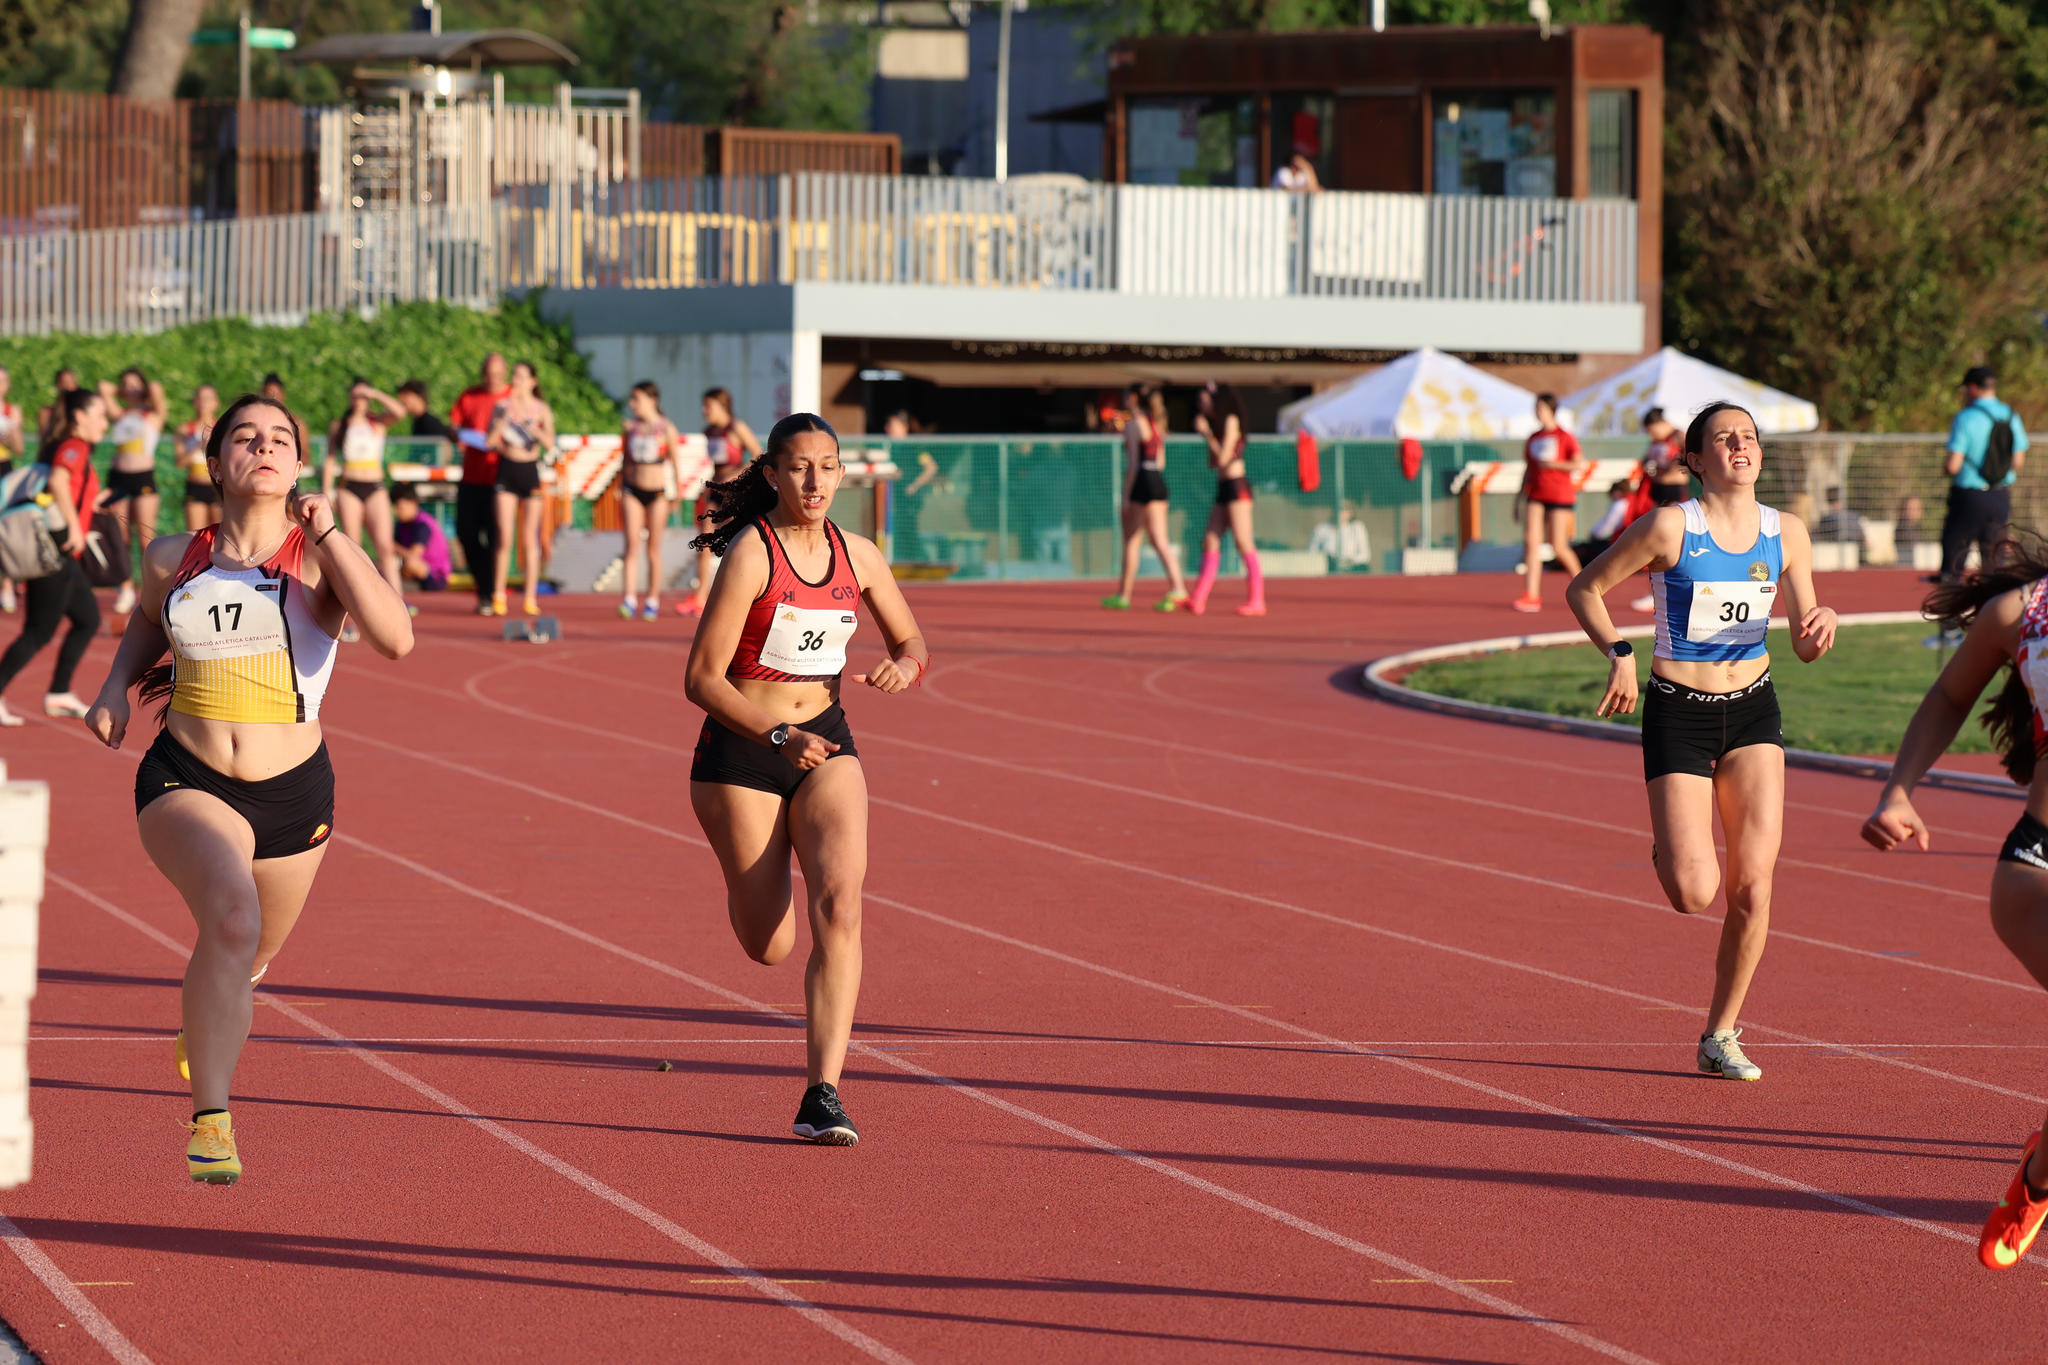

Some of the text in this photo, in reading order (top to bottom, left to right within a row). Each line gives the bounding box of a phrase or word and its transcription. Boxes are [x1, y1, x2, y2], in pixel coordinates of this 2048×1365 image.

[208, 603, 243, 632] 17
[1719, 602, 1750, 623] 30
[244, 633, 280, 642] CATALUNYA
[798, 630, 826, 651] 36
[1686, 691, 1744, 702] NIKE
